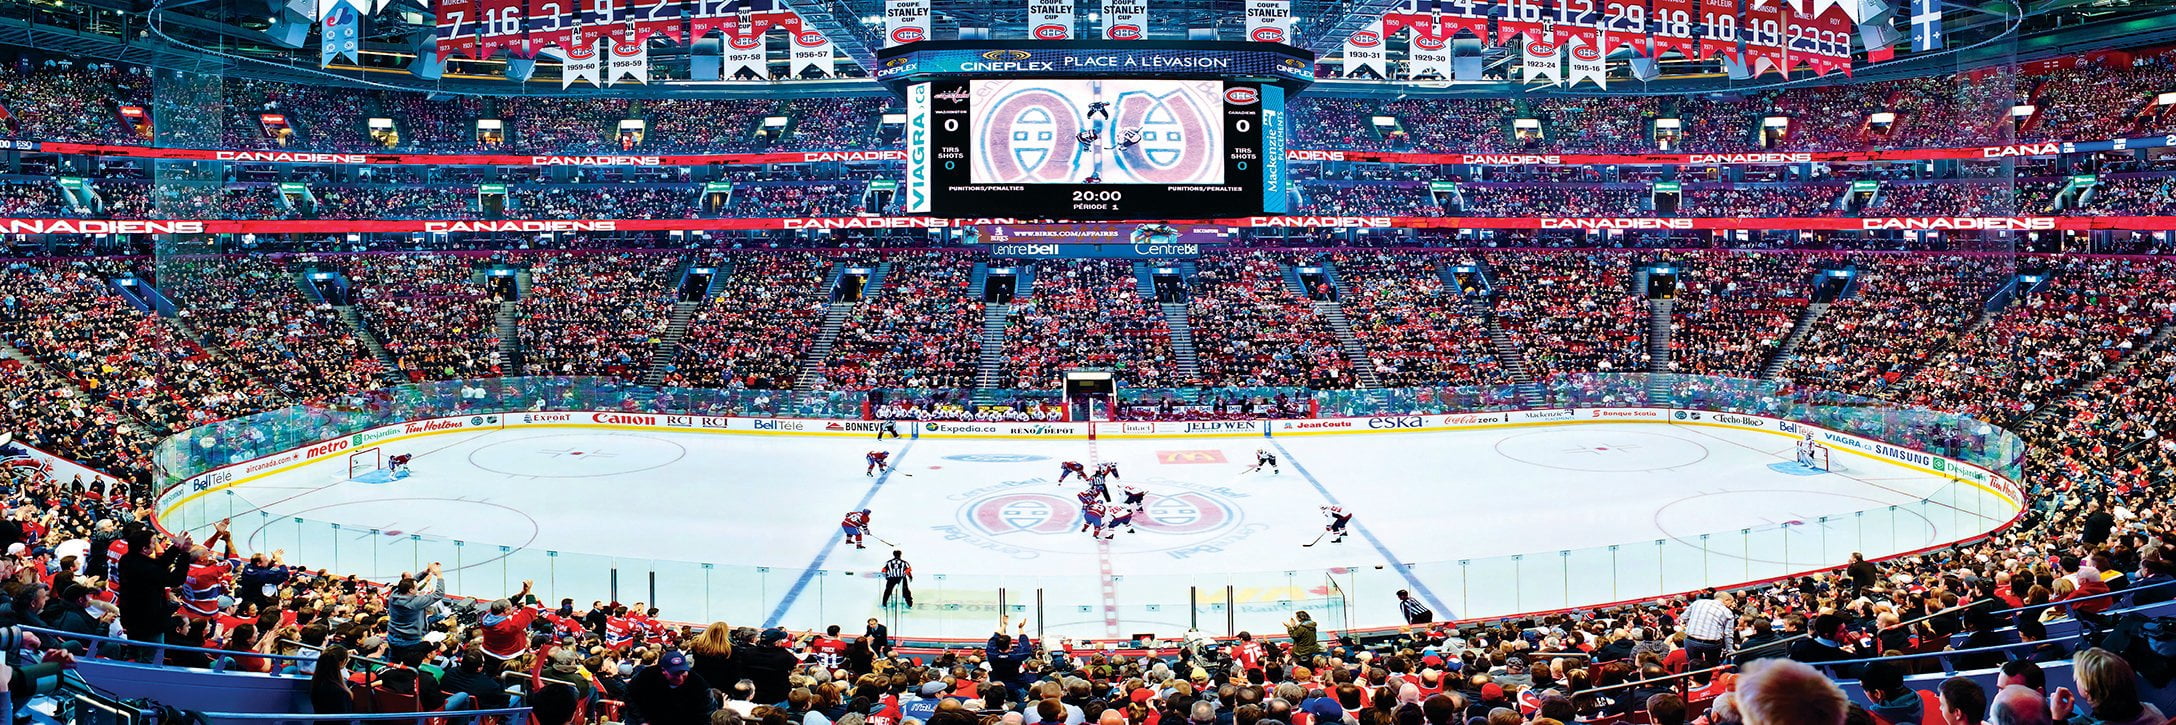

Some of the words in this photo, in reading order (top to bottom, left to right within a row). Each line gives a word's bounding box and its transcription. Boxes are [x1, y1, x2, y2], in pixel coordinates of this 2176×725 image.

[888, 8, 928, 16] STANLEY
[1030, 6, 1072, 14] STANLEY
[1104, 6, 1145, 14] STANLEY
[1248, 9, 1288, 17] STANLEY
[486, 6, 520, 37] 16
[542, 3, 561, 32] 3
[1607, 4, 1644, 34] 29
[1658, 8, 1690, 38] 18
[446, 11, 464, 40] 7
[1705, 12, 1736, 42] 10
[1750, 18, 1778, 48] 19
[1788, 24, 1820, 52] 23
[1821, 30, 1850, 58] 33
[1064, 57, 1117, 67] PLACE
[1124, 54, 1137, 66] À
[1414, 54, 1446, 62] 1929-30
[878, 63, 917, 77] CINEPLEX
[960, 62, 1052, 71] CINEPLEX
[1276, 64, 1314, 78] CINEPLEX
[944, 118, 958, 132] 0
[1236, 120, 1250, 132] 0
[804, 151, 908, 162] CANADIEN
[1286, 151, 1344, 160] ADIENS
[1984, 143, 2060, 158] CANA
[216, 152, 366, 164] CANADIENS
[532, 156, 660, 165] CANADIENS
[1266, 129, 1278, 192] Mackenzie
[1463, 154, 1560, 165] CANADIENS
[1690, 152, 1812, 164] CANADIENS
[945, 160, 955, 170] 0
[1238, 162, 1248, 170] 0
[1072, 191, 1122, 201] 20:00
[425, 222, 616, 232] CANADIENS
[784, 218, 948, 229] CANADIENS
[1251, 216, 1392, 228] CANADIENS
[1541, 218, 1693, 230] CANADIENS
[1862, 218, 2056, 230] CANADIENS
[1135, 242, 1198, 254] CentreBell
[592, 414, 656, 426] Canon
[668, 416, 692, 424] RCI
[702, 418, 728, 426] RCI
[1368, 416, 1422, 430] eska
[1720, 414, 1759, 426] Techo-Bloc
[405, 423, 422, 434] Tim
[424, 420, 462, 432] Hortons
[846, 422, 883, 432] BONNEV
[940, 424, 996, 434] Expedia.ca
[364, 428, 400, 442] Desjardins
[306, 440, 348, 459] metro
[1876, 445, 1930, 466] SAMSUNG
[246, 456, 291, 474] aircanada.com
[1990, 475, 2002, 492] Tim
[820, 653, 838, 668] 31
